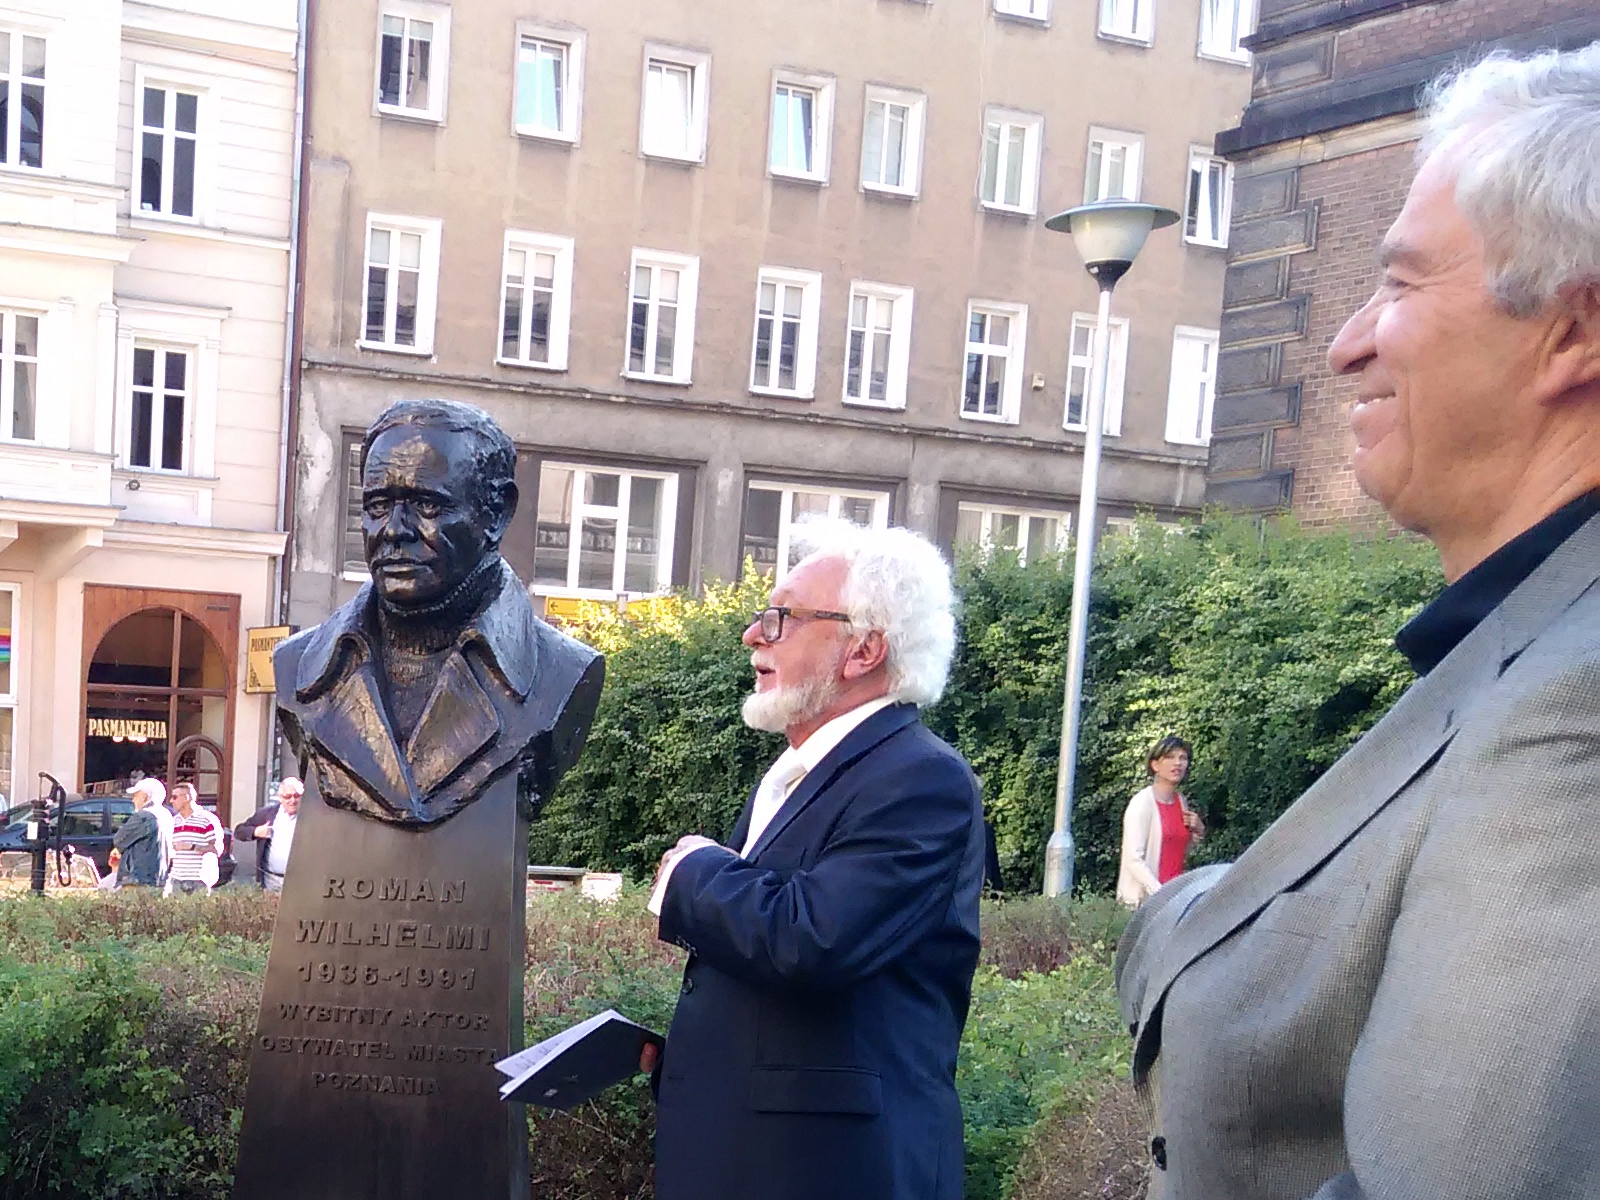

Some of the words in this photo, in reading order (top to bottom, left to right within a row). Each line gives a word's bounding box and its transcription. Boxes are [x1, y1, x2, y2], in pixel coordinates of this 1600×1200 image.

[88, 718, 167, 739] PASMANTERIA
[323, 874, 467, 903] ROMAN
[294, 919, 491, 951] WILHELMI
[298, 961, 477, 991] 1936-1991
[276, 1002, 393, 1027] WYBITNY
[399, 1008, 490, 1032] AKTOR
[258, 1035, 397, 1061] OBYWATEL
[404, 1043, 499, 1066] MIASTA
